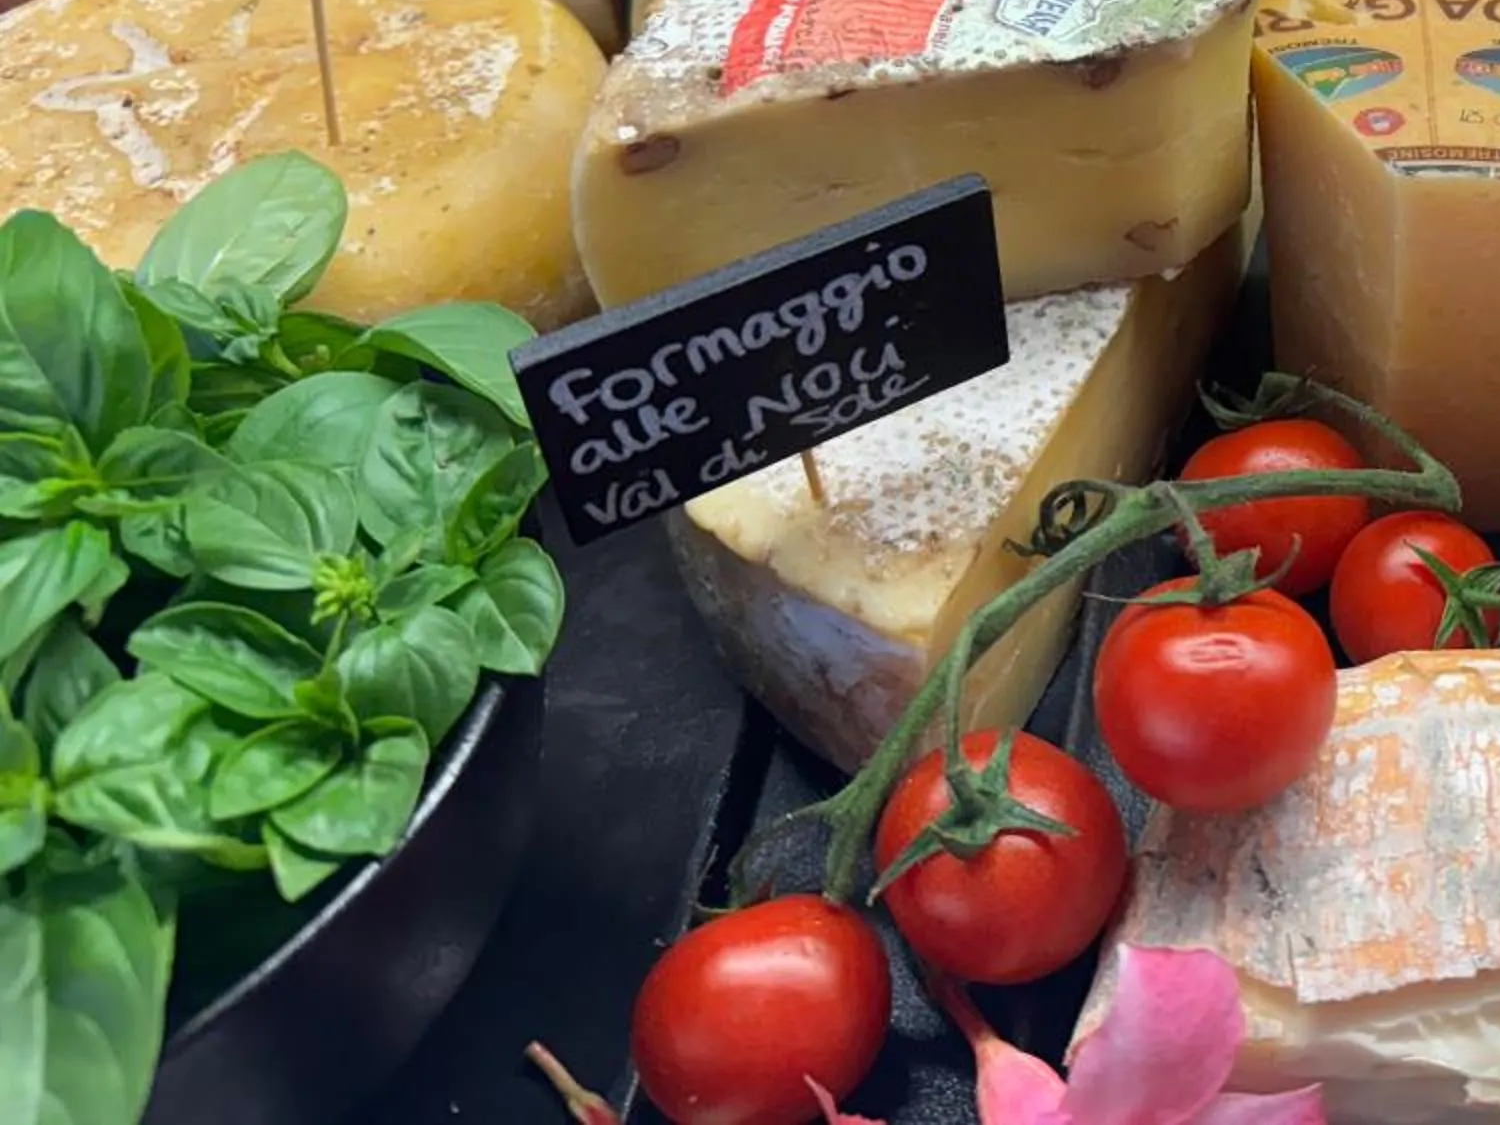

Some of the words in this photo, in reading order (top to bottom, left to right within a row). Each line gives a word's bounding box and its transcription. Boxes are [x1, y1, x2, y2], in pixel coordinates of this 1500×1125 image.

[547, 242, 928, 426] Formaggio
[571, 394, 710, 475] alle
[701, 431, 768, 483] di
